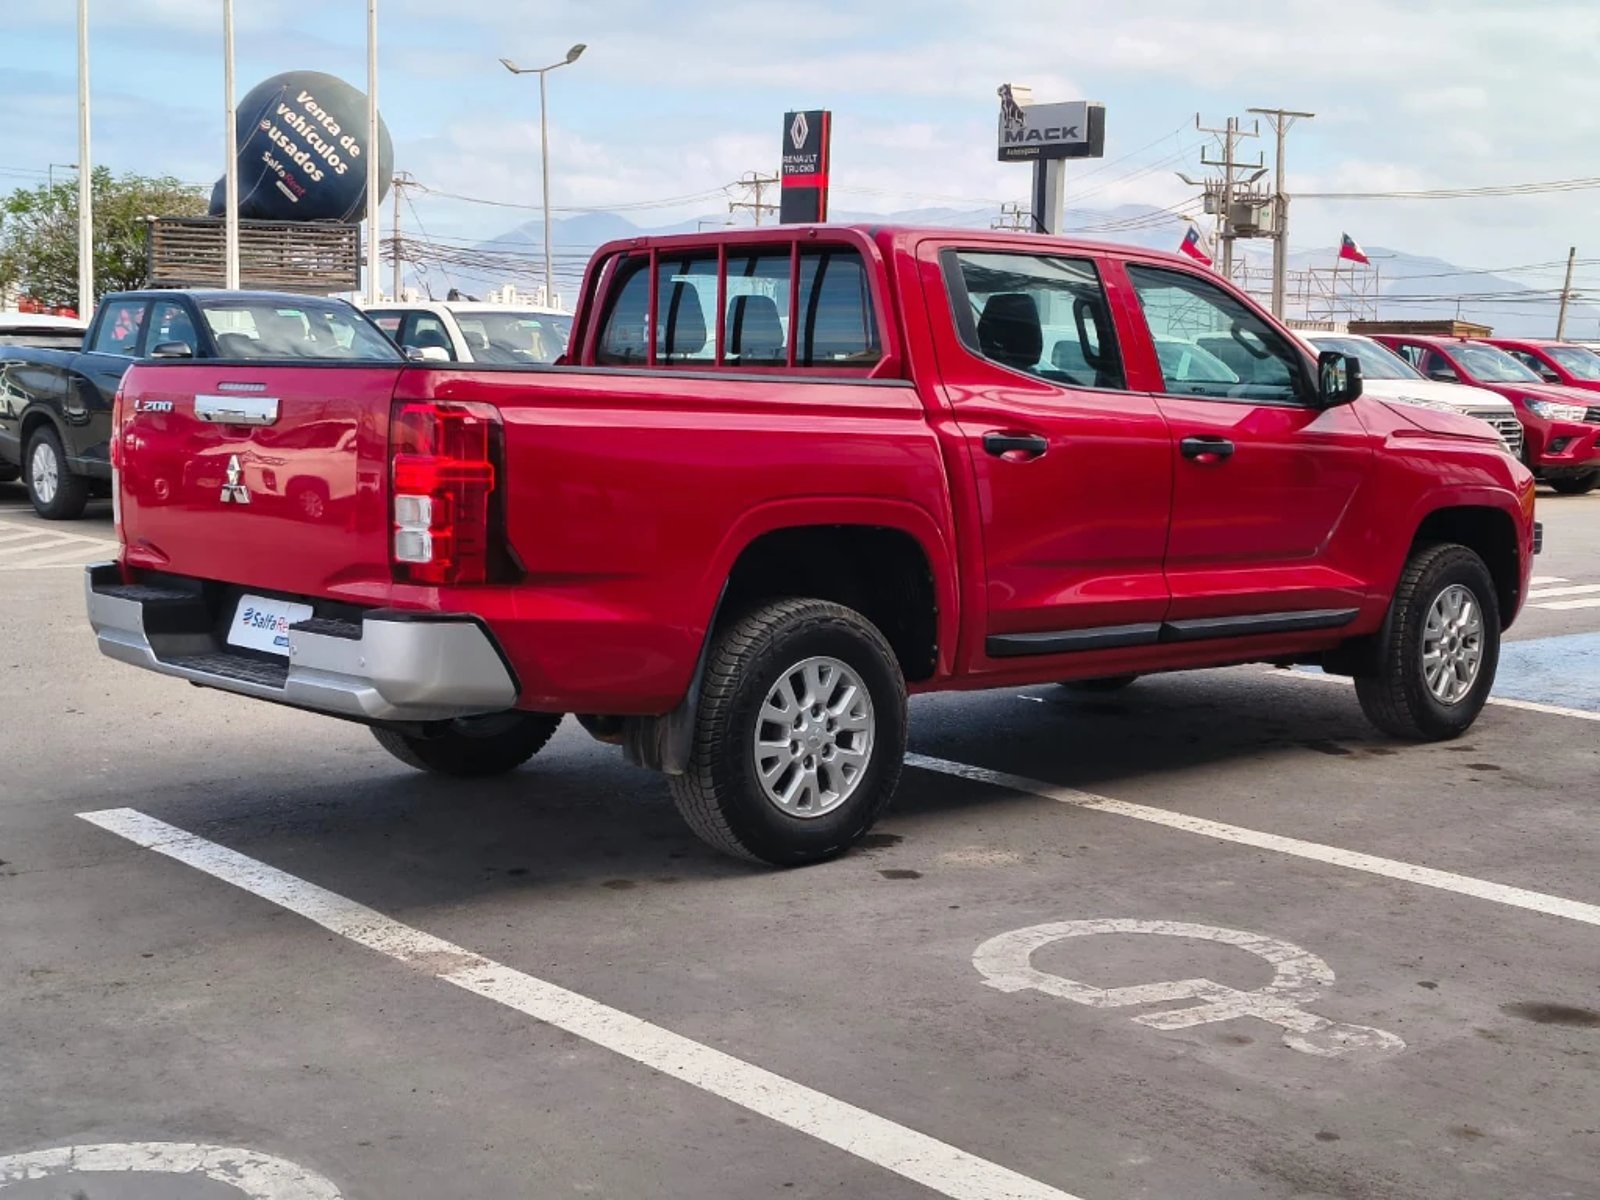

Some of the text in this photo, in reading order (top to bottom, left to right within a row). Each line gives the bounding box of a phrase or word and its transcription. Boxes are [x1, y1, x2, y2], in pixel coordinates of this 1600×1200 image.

[296, 90, 361, 158] Venta de
[276, 103, 348, 175] vehículos
[1004, 126, 1079, 143] MACK
[268, 126, 325, 182] usados
[783, 154, 818, 163] RENAULT
[784, 164, 815, 174] TRUCKS
[134, 399, 173, 412] L200
[251, 611, 289, 633] SalfaRe
